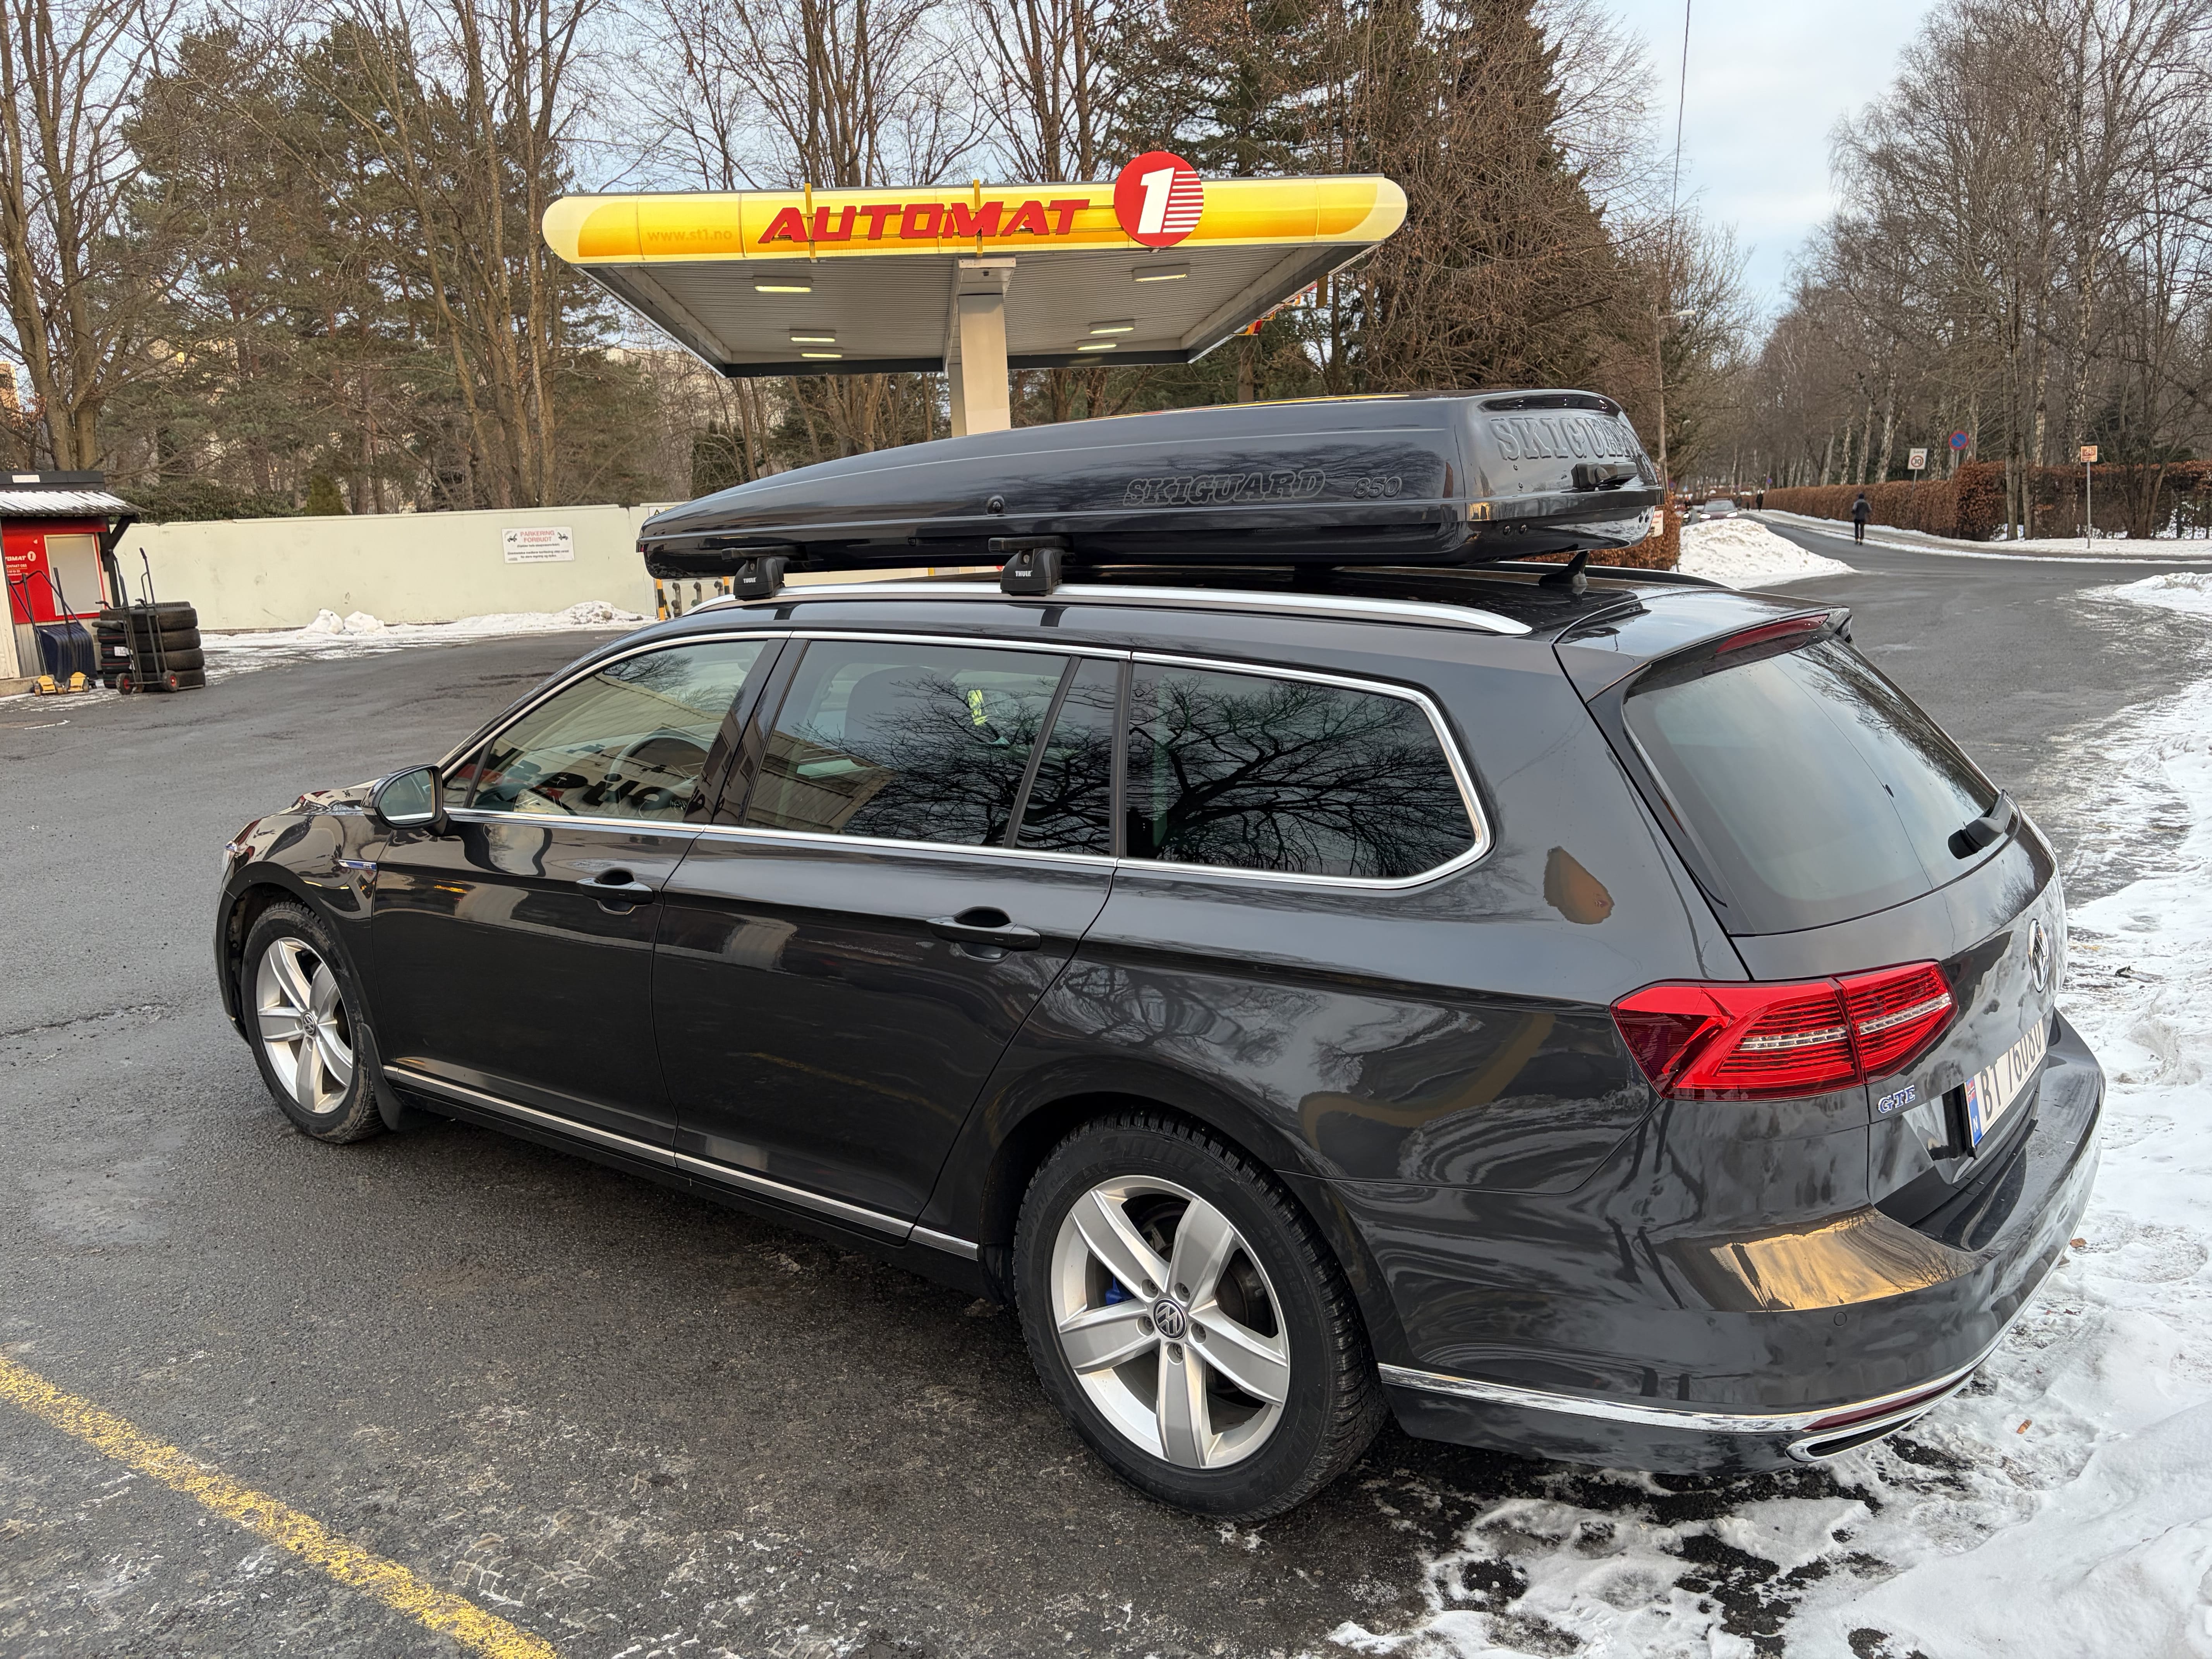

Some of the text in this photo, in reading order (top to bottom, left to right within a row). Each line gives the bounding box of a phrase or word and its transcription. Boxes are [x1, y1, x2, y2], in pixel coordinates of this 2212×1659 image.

[758, 167, 1175, 244] AUTOMAT 1
[647, 229, 732, 241] www.st1.no
[1490, 417, 1643, 460] SKIGUARD
[1123, 469, 1402, 505] SKIGUARD 850
[1877, 1085, 1915, 1113] GTE
[1980, 1065, 2001, 1121] BT
[1973, 1115, 1979, 1133] N
